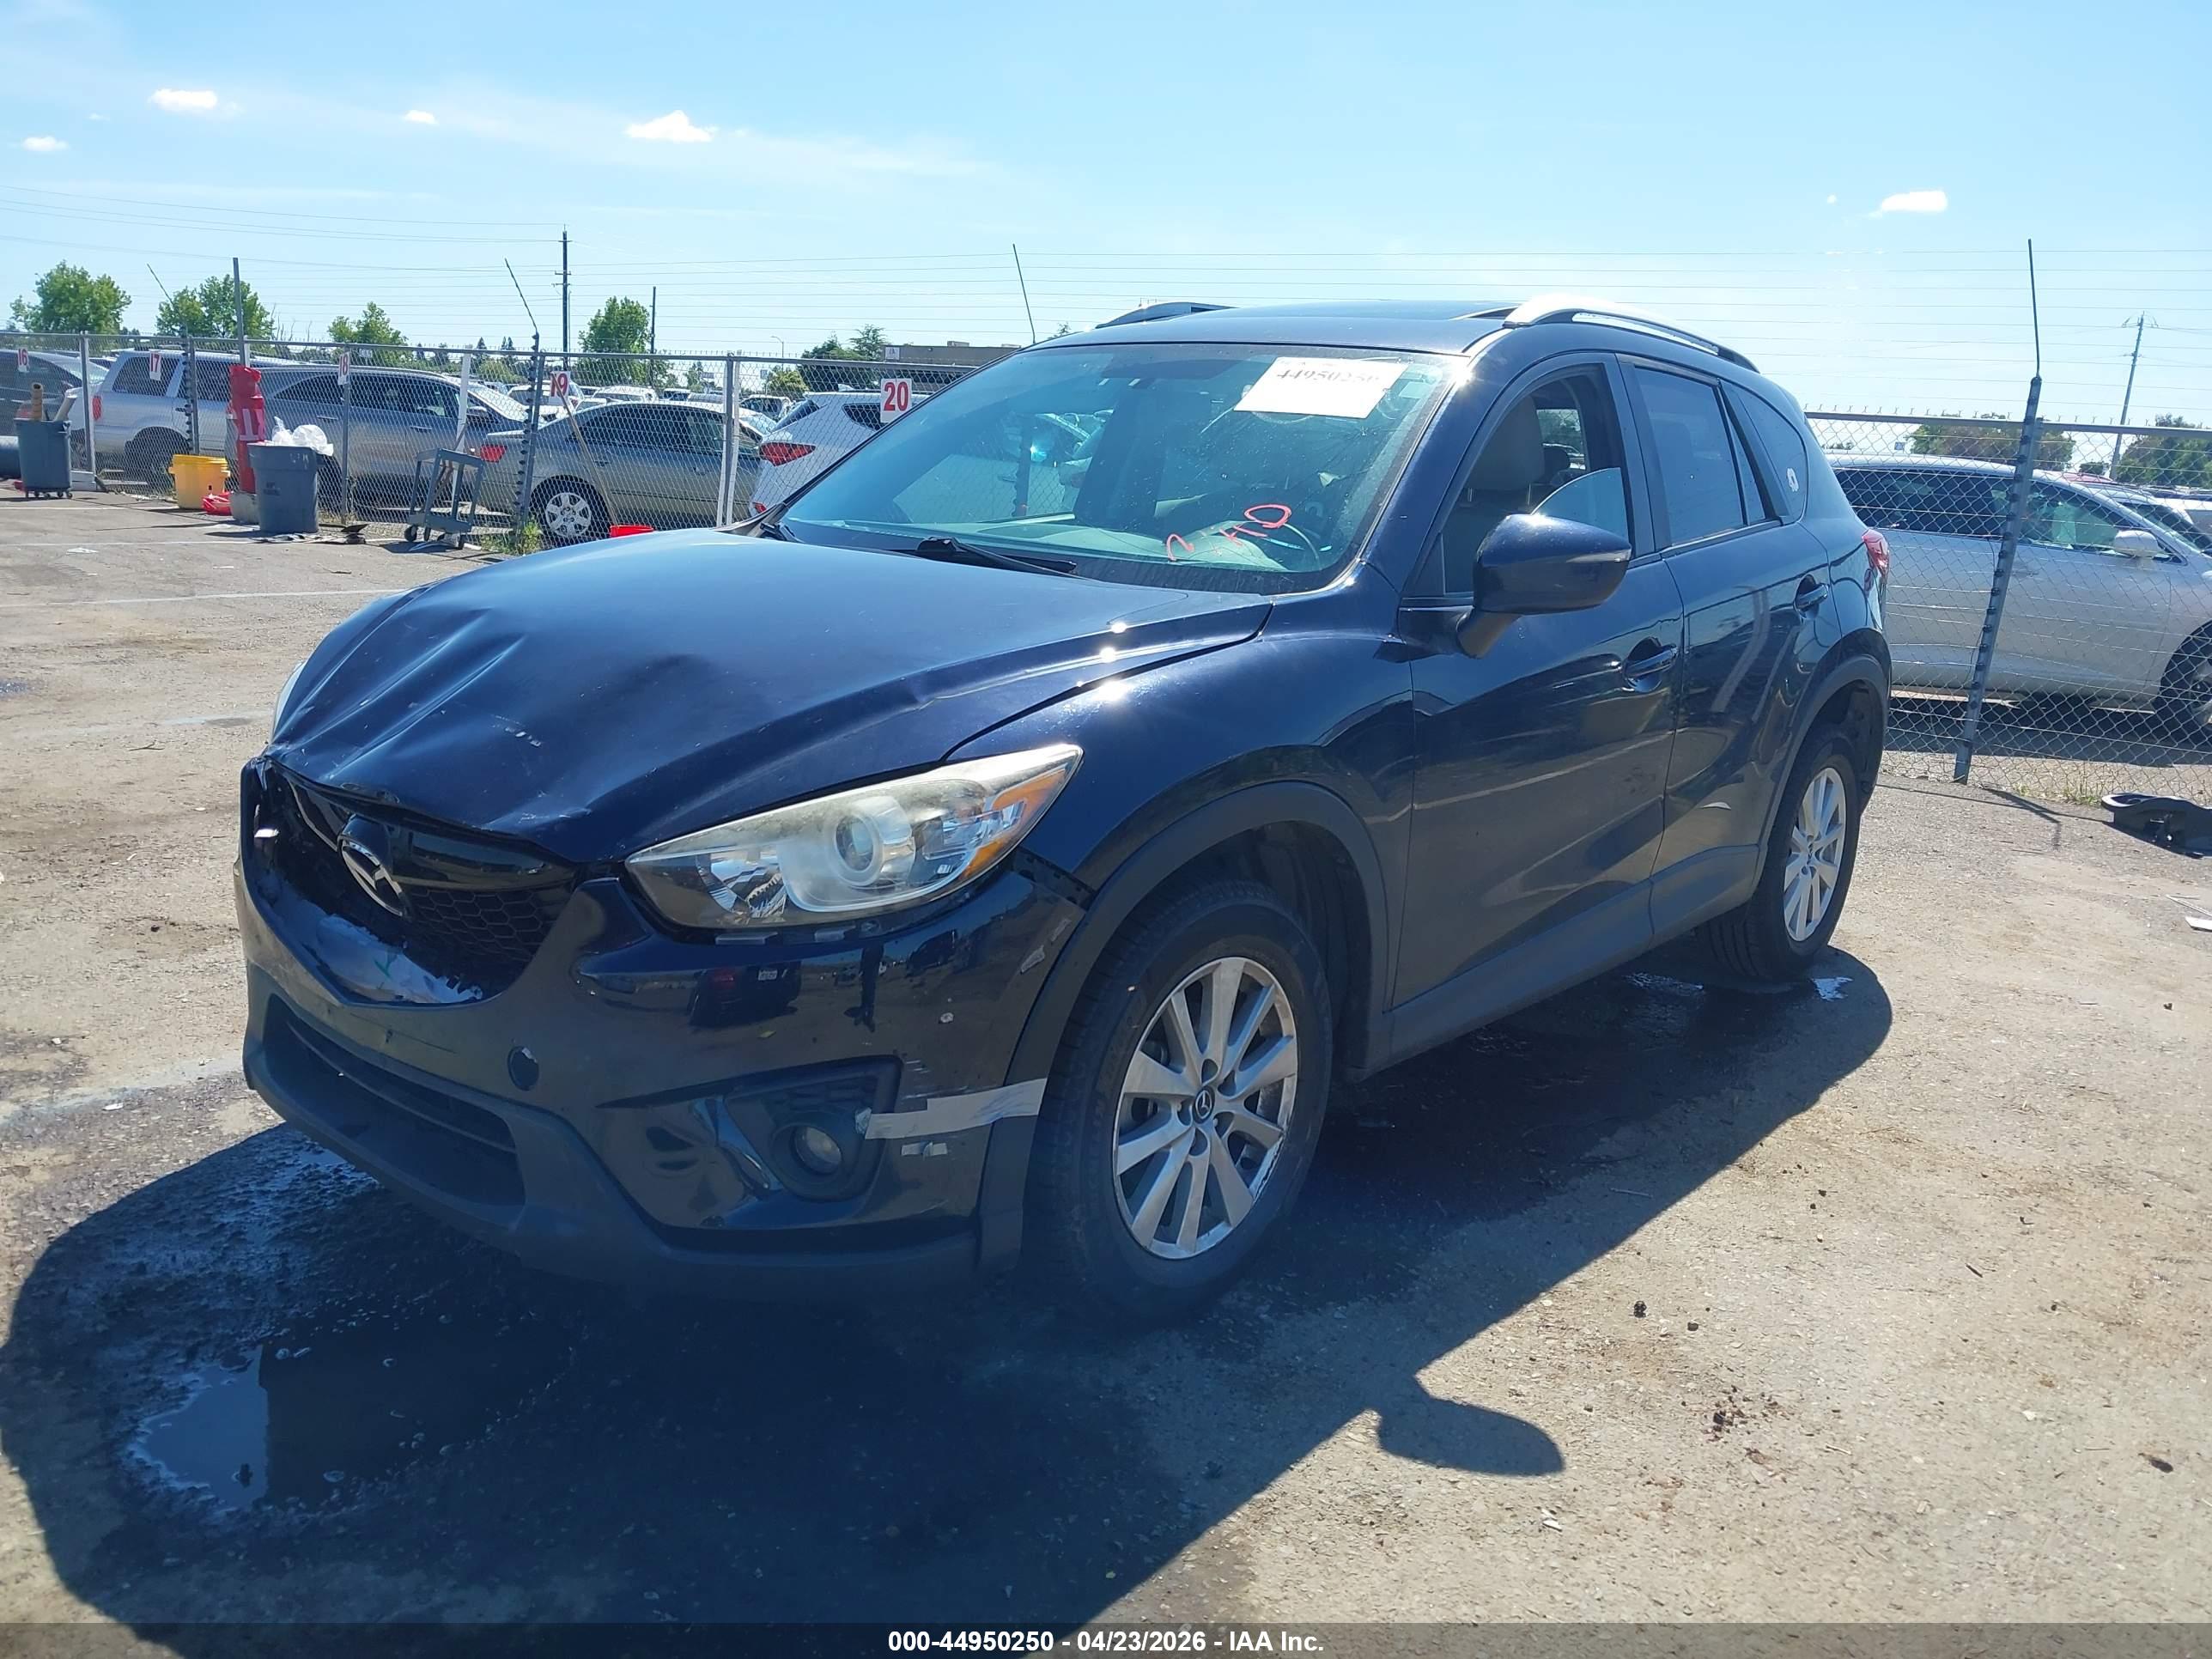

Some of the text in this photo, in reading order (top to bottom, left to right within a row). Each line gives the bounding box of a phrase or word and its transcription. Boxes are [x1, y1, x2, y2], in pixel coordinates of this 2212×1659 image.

[18, 349, 27, 366] 16
[150, 353, 160, 373] 17
[339, 354, 348, 377] 18
[550, 373, 568, 398] 19
[884, 381, 908, 411] 20
